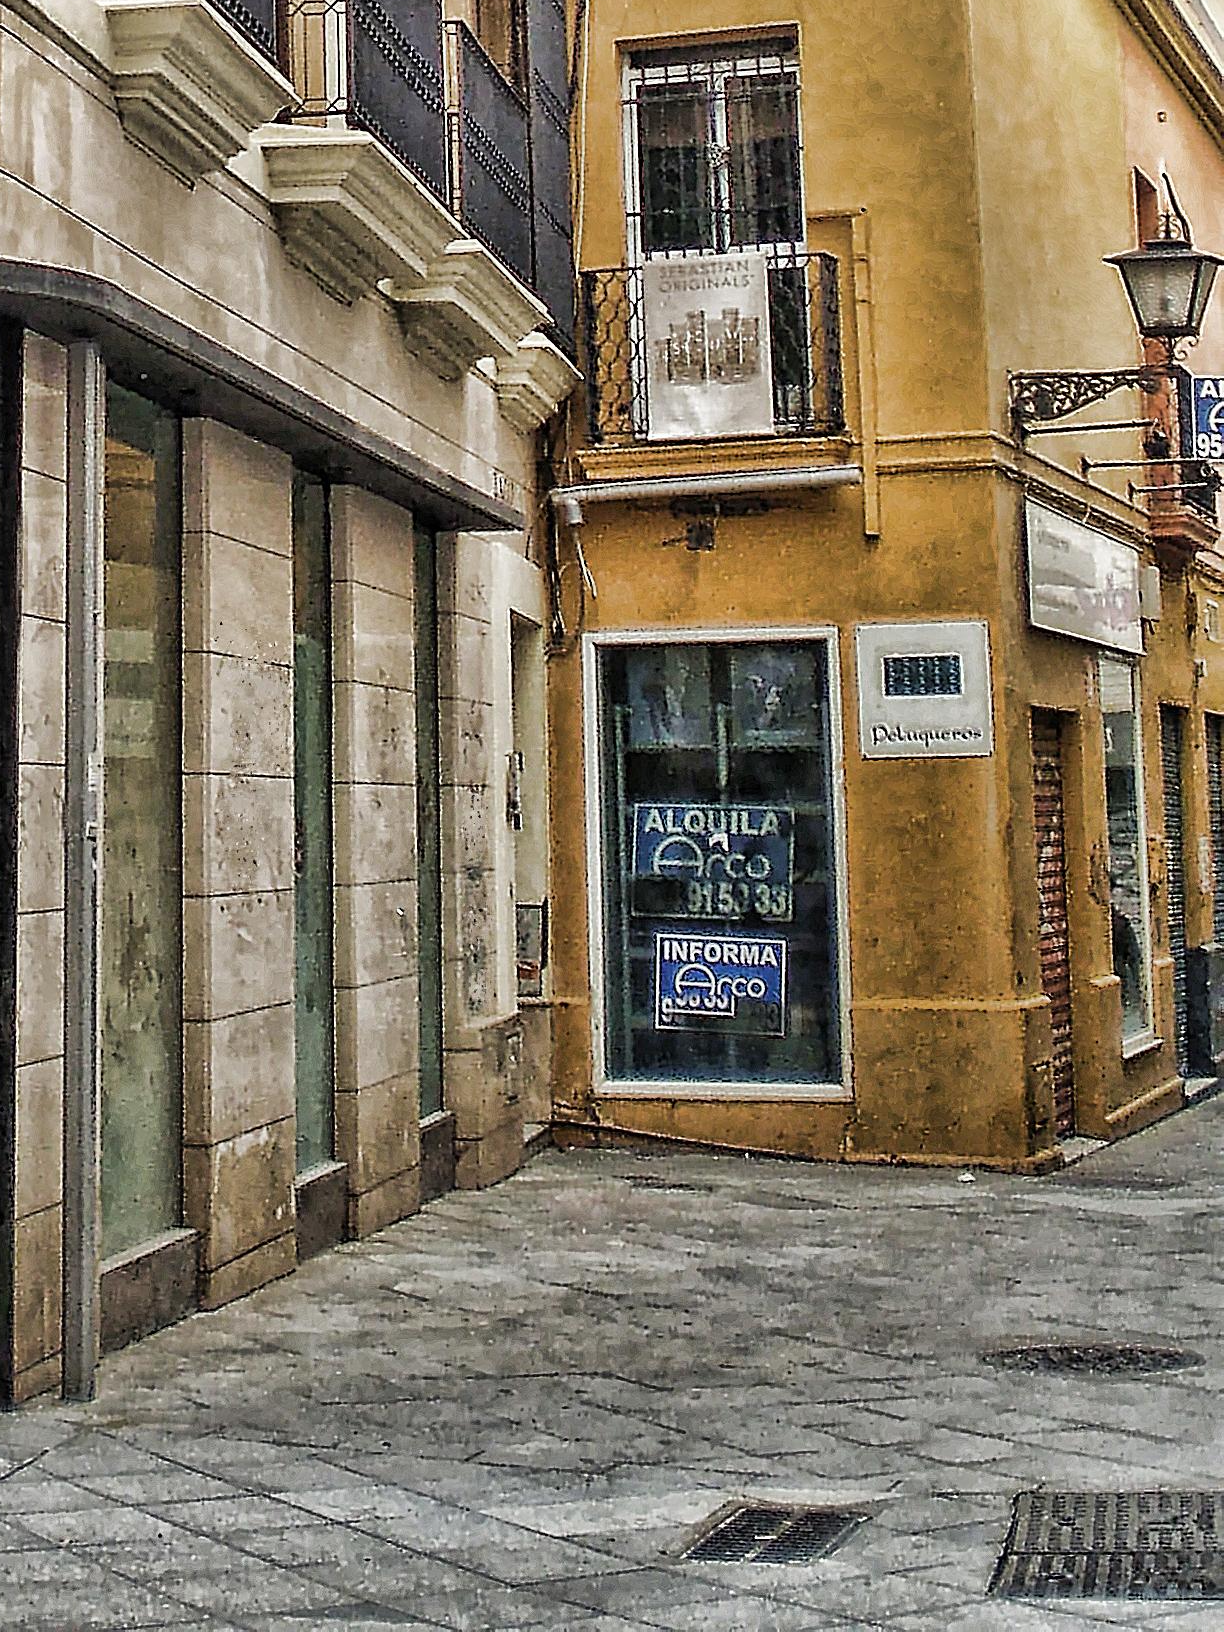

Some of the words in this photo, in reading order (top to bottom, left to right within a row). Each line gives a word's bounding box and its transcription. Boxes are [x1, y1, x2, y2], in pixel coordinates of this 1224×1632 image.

[645, 809, 780, 836] ALQUILA
[654, 836, 772, 879] Arco
[663, 940, 778, 967] INFORMA
[674, 964, 767, 998] Arco
